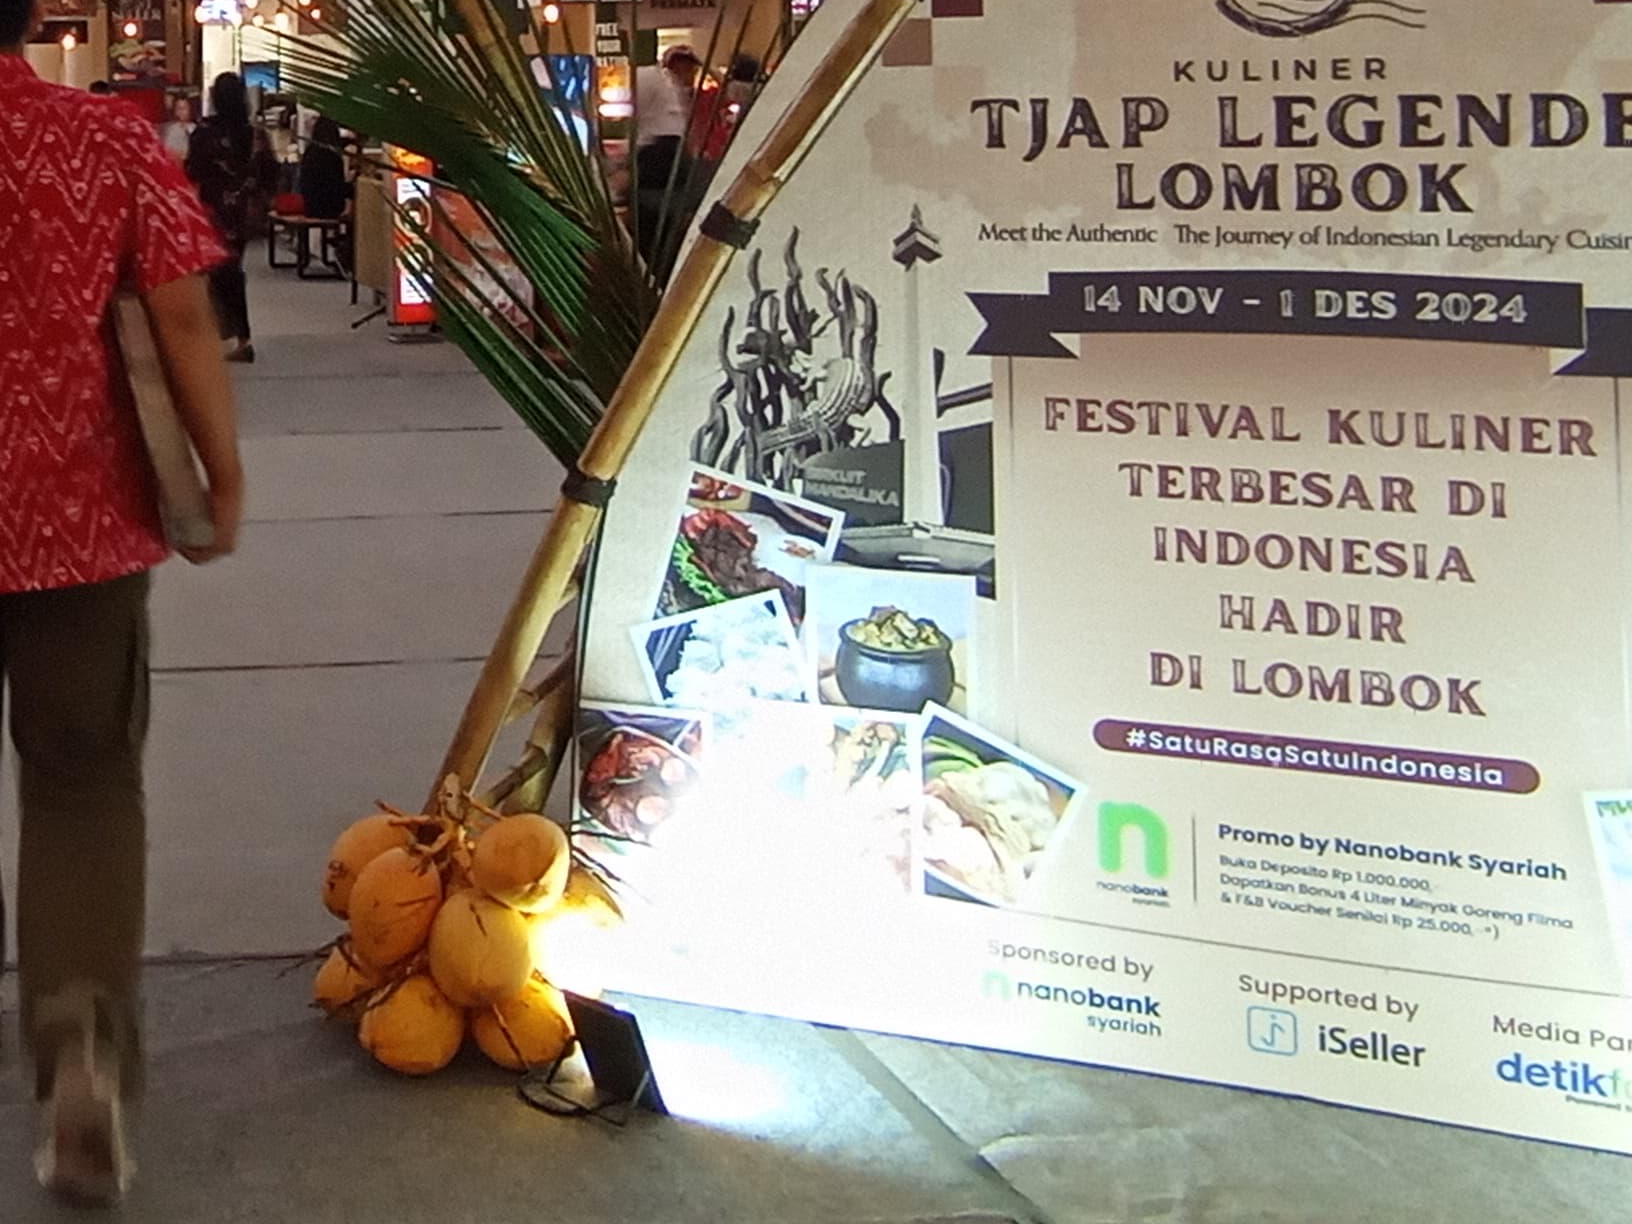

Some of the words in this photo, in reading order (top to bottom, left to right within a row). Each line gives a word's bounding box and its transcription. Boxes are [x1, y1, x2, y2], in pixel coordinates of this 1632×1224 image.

[1172, 57, 1388, 83] KULINER
[970, 96, 1169, 162] TJAP
[1216, 92, 1632, 150] LEGENDE
[1116, 162, 1474, 213] LOMBOK
[978, 223, 1028, 244] Meet
[1031, 223, 1063, 243] the
[1174, 223, 1210, 245] The
[1214, 225, 1293, 251] Journey
[1299, 223, 1321, 247] of
[1325, 225, 1439, 249] Indonesian
[1445, 227, 1560, 254] Legendary
[1082, 284, 1122, 313] 14
[1138, 285, 1225, 316] NOV
[1279, 288, 1294, 318] 1
[1314, 289, 1397, 320] DES
[1415, 291, 1529, 324] 2024
[1043, 396, 1302, 444] FESTIVAL
[1327, 407, 1599, 459] KULINER
[1118, 461, 1417, 515] TERBESAR
[1447, 478, 1509, 520] DI
[1153, 525, 1477, 584] INDONESIA
[1219, 593, 1407, 646] HADIR
[1149, 651, 1205, 692] DI
[1232, 657, 1488, 718] LOMBOK
[1126, 726, 1506, 788] #SatuRasaSatuIndonesia
[1217, 823, 1296, 850] Promo
[1299, 832, 1331, 858] by
[1334, 837, 1464, 869] Nanobank
[1467, 853, 1569, 882] Syariah
[1219, 854, 1258, 870] Buka
[1260, 858, 1329, 880] Deposito
[1331, 868, 1354, 885] Rp
[1097, 880, 1170, 899] nanobank
[1219, 873, 1296, 895] Dapatkan
[1298, 882, 1347, 902] Bonus
[1350, 889, 1362, 902] 4
[1363, 890, 1398, 907] Liter
[1401, 894, 1459, 918] Minyak
[1462, 904, 1525, 927] Goreng
[1268, 898, 1334, 921] Voucher
[1336, 905, 1389, 926] Senilai
[988, 938, 1118, 972] Sponsored
[1123, 956, 1155, 982] by
[1017, 979, 1162, 1019] nanobank
[1238, 973, 1378, 1014] Supported
[1385, 992, 1421, 1023] by
[1086, 1015, 1163, 1039] syariah
[1317, 1024, 1427, 1070] iSeller
[1492, 1014, 1581, 1046] Media
